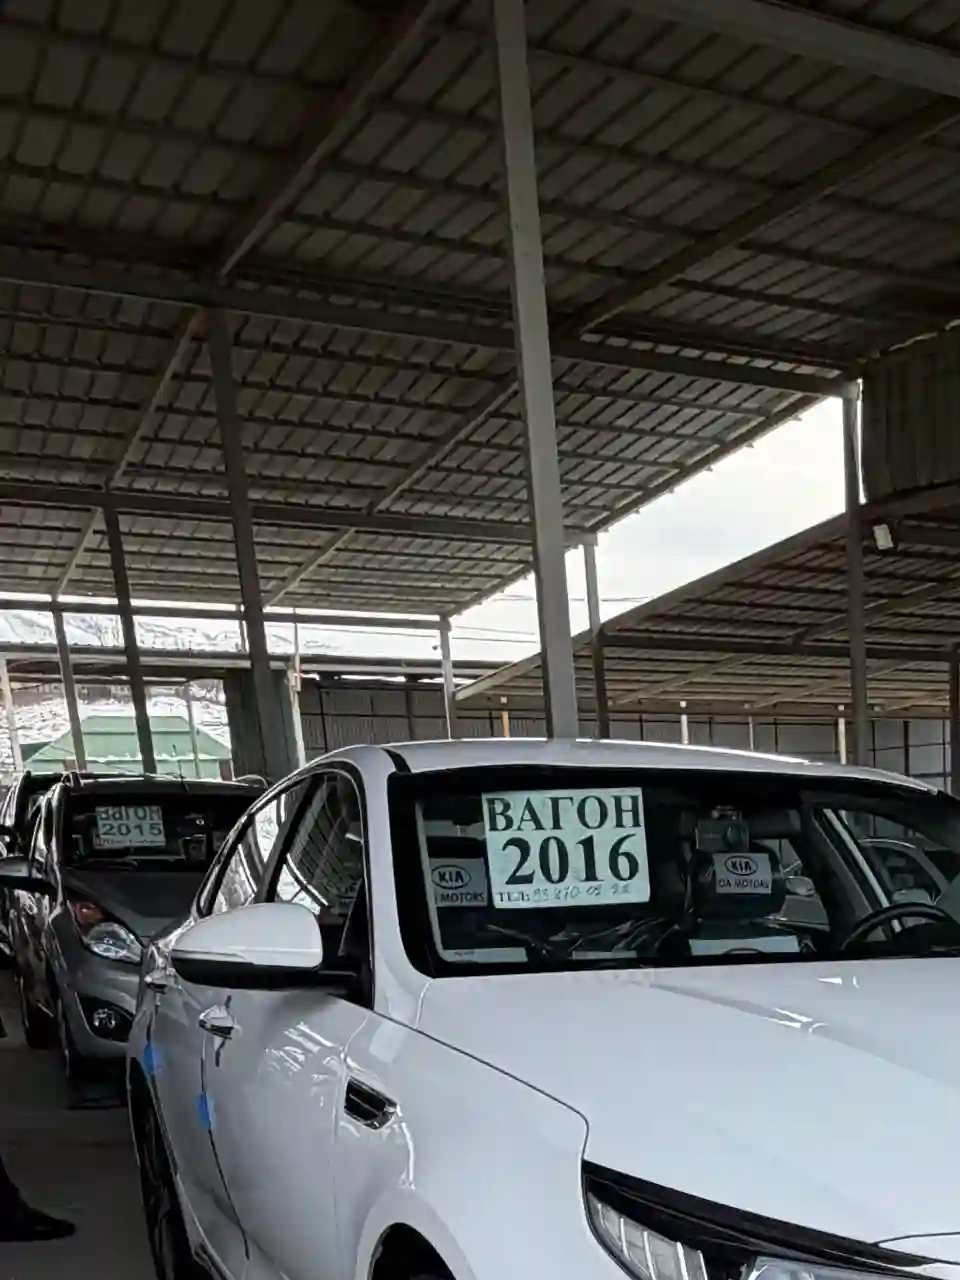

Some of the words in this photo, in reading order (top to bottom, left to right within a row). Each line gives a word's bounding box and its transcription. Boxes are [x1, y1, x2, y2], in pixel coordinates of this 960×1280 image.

[487, 794, 642, 832] ВАГОН
[102, 822, 162, 837] 2015
[502, 833, 640, 885] 2016
[437, 870, 465, 884] KIA
